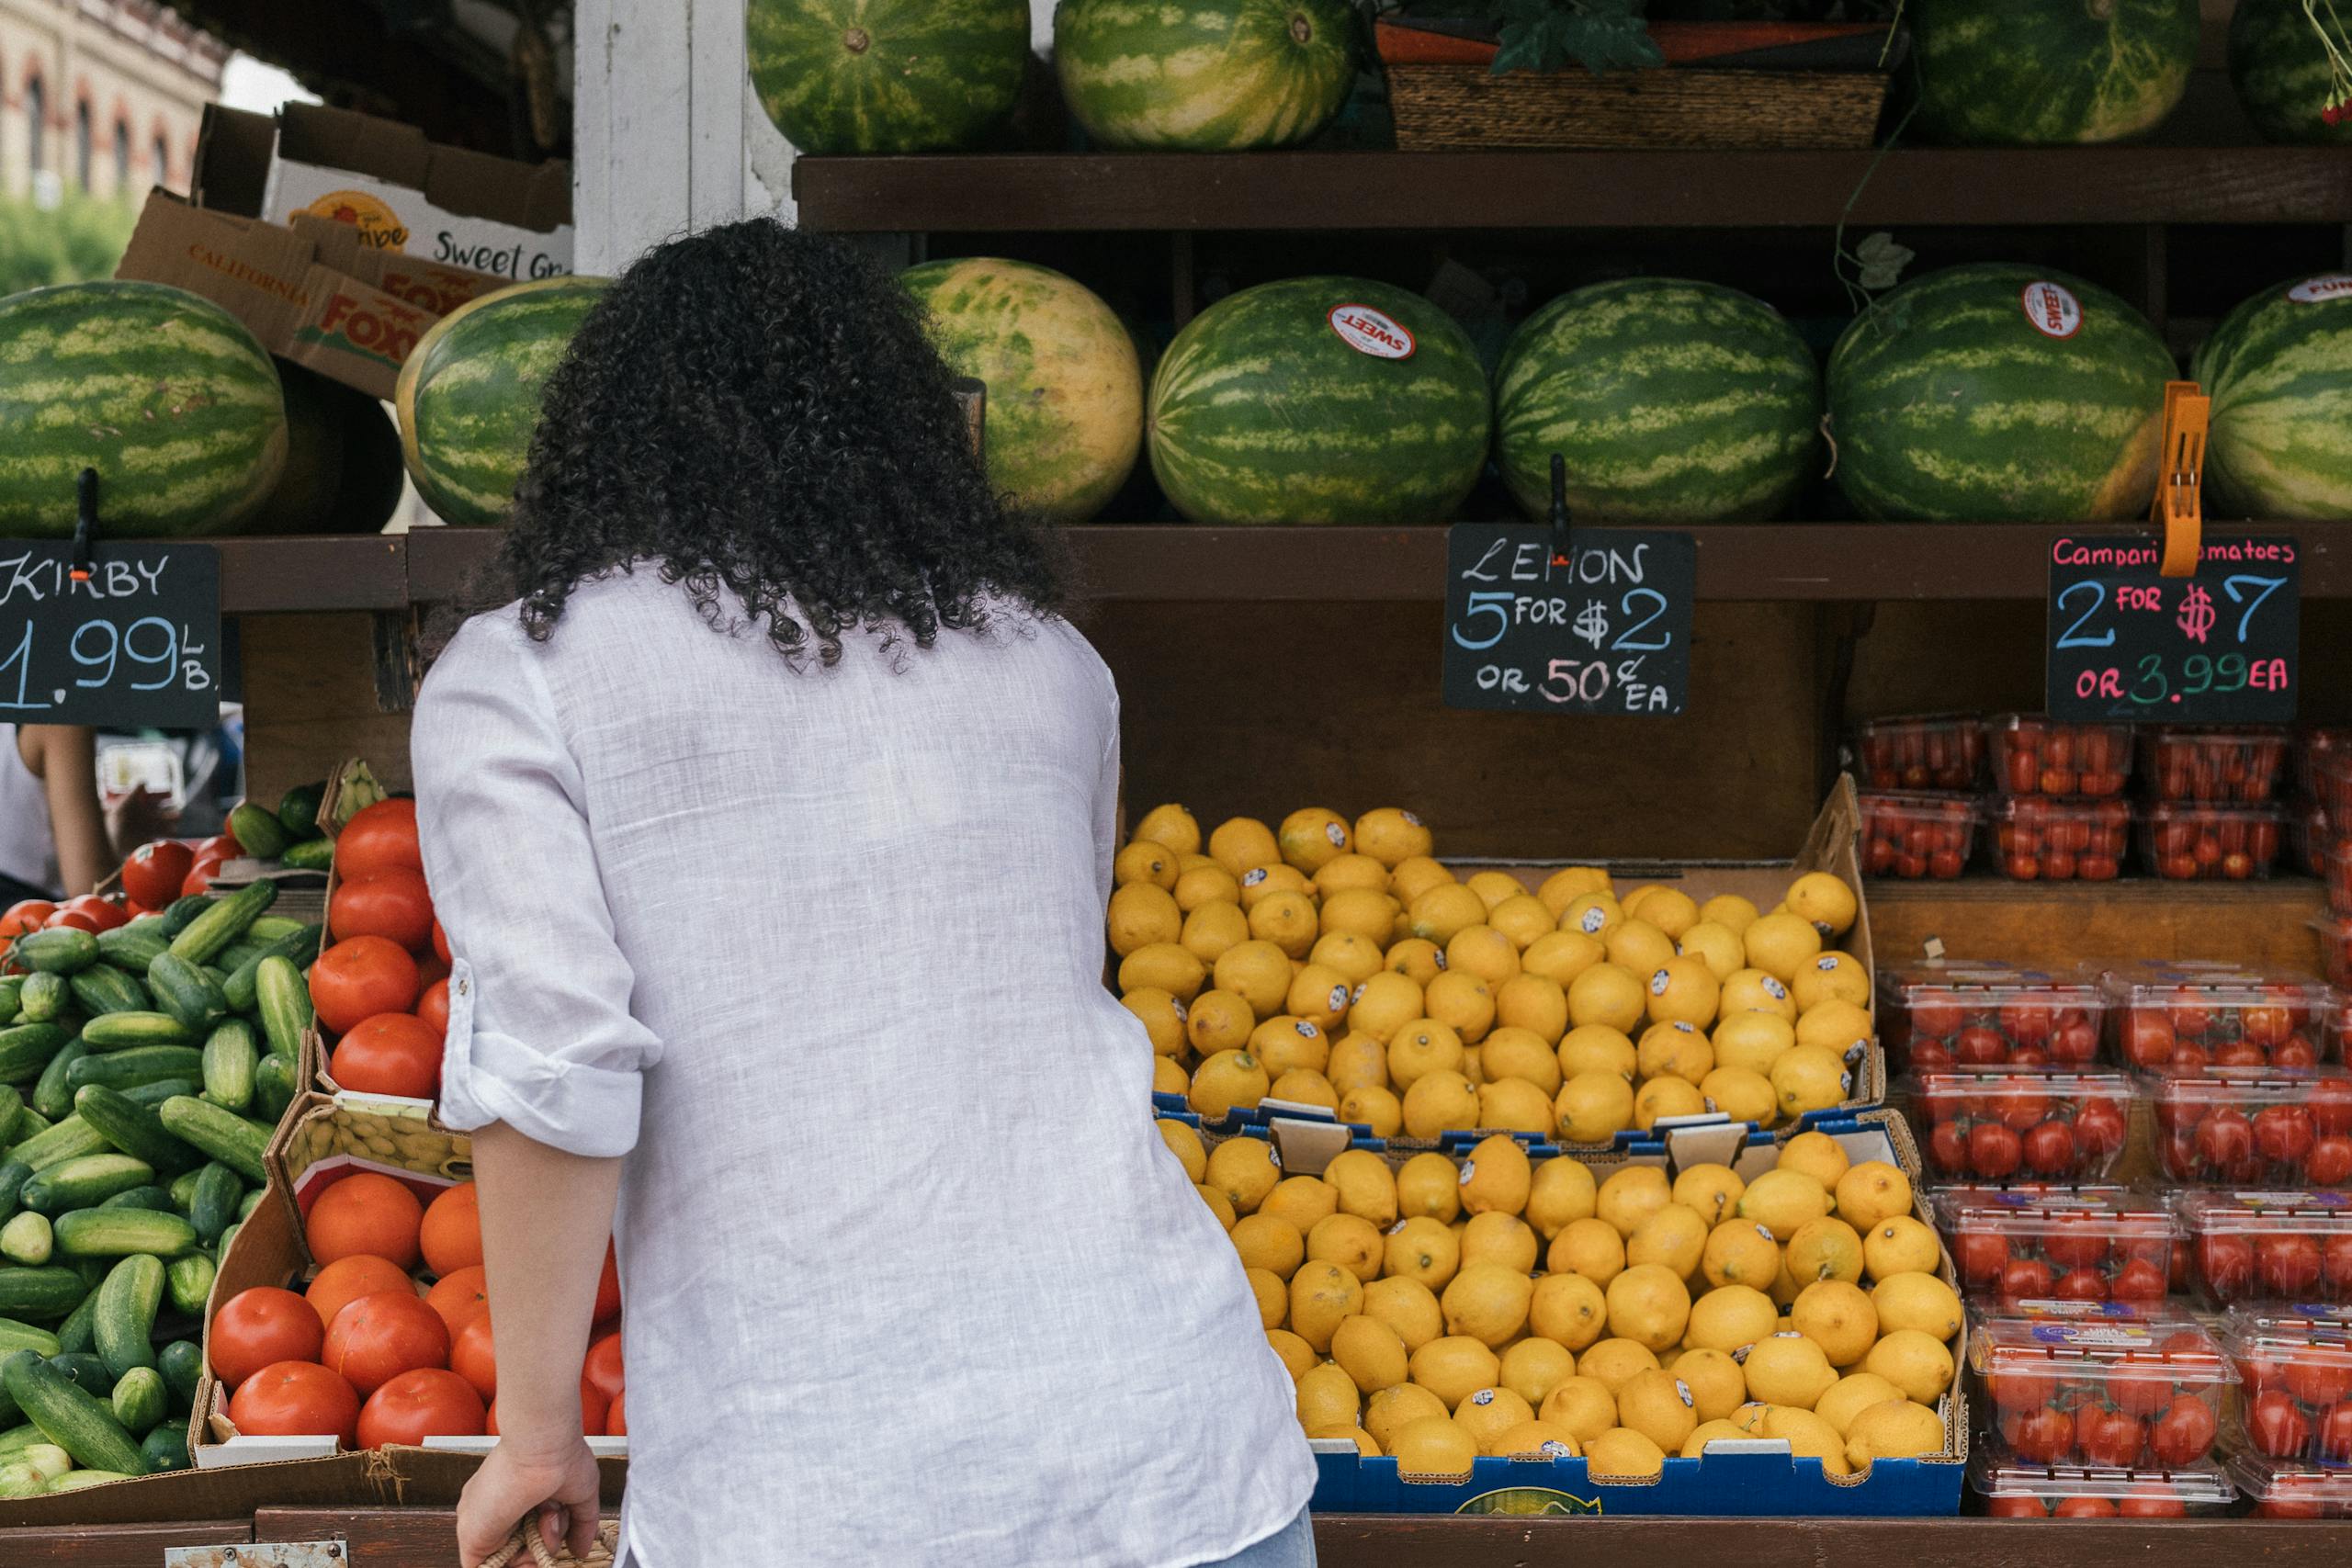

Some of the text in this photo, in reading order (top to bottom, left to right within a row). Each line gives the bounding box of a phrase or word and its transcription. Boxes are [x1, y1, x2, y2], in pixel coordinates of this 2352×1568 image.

[189, 244, 309, 306] CALIFORNIA
[435, 231, 573, 281] Sweet Gr
[1342, 314, 1405, 350] SWEET
[2042, 288, 2064, 331] SWEET
[0, 550, 169, 606] KIRBY
[2052, 538, 2296, 570] Campari omatoes
[1452, 591, 1515, 650] 5
[1515, 596, 1566, 626] FOR
[2056, 580, 2116, 649] 2
[2116, 586, 2162, 612] FOR
[1476, 664, 1531, 694] OR
[2076, 652, 2289, 705] OR 3.99 EA
